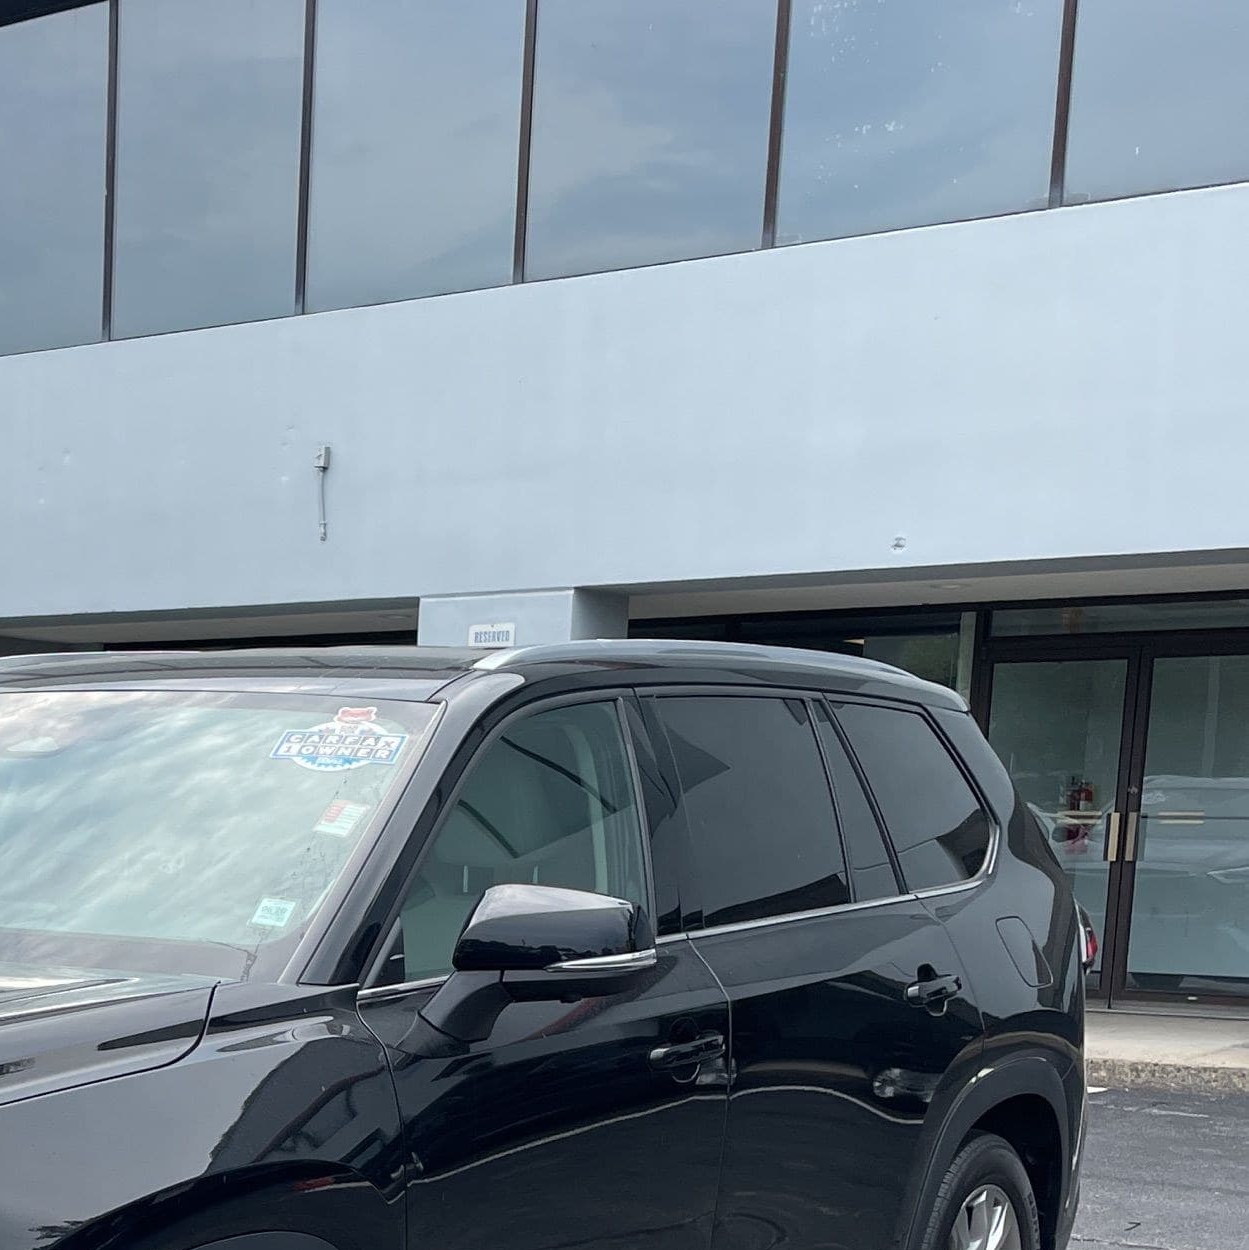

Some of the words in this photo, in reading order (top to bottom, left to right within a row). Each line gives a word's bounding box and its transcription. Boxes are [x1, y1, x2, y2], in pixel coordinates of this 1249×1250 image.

[474, 631, 510, 643] RESERVED
[287, 733, 397, 749] CARFAX
[300, 745, 390, 759] OWNER
